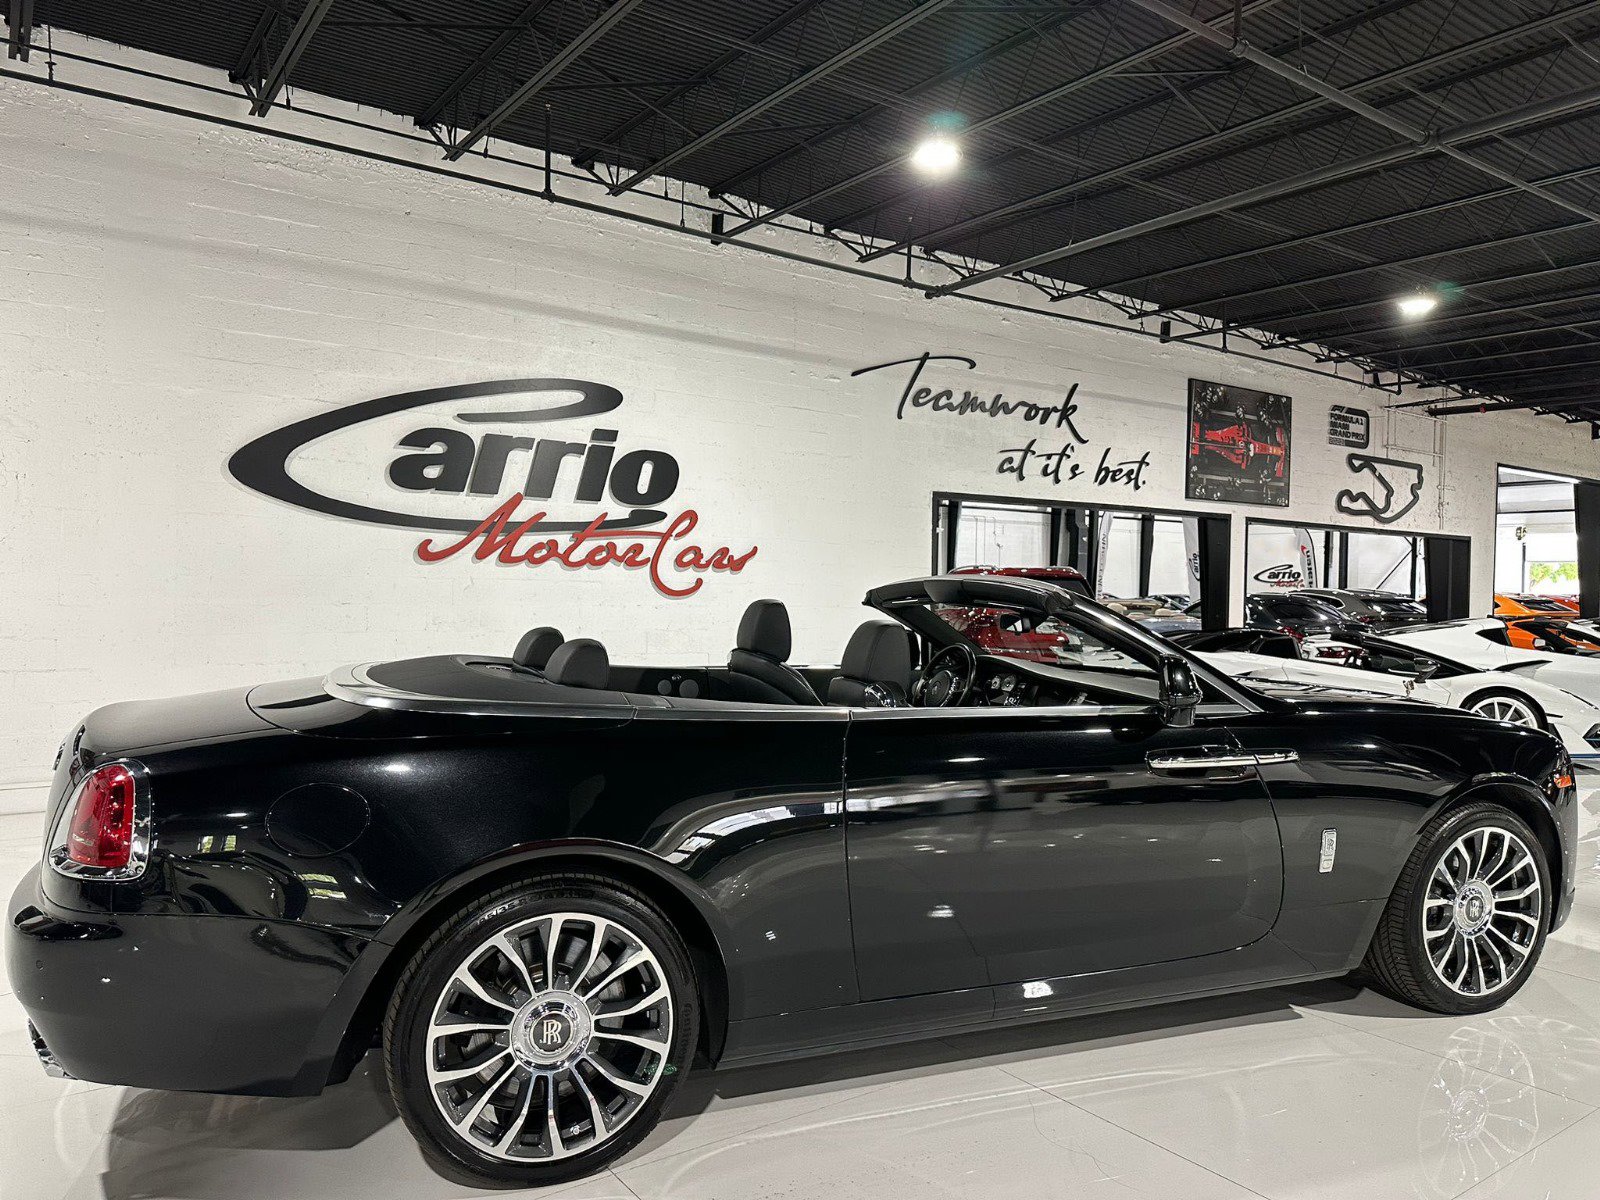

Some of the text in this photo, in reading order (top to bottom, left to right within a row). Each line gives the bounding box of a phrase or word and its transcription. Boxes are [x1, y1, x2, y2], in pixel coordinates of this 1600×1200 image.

[851, 352, 1089, 444] Teamwork
[228, 378, 680, 533] Carrio
[998, 439, 1150, 491] at it's best.
